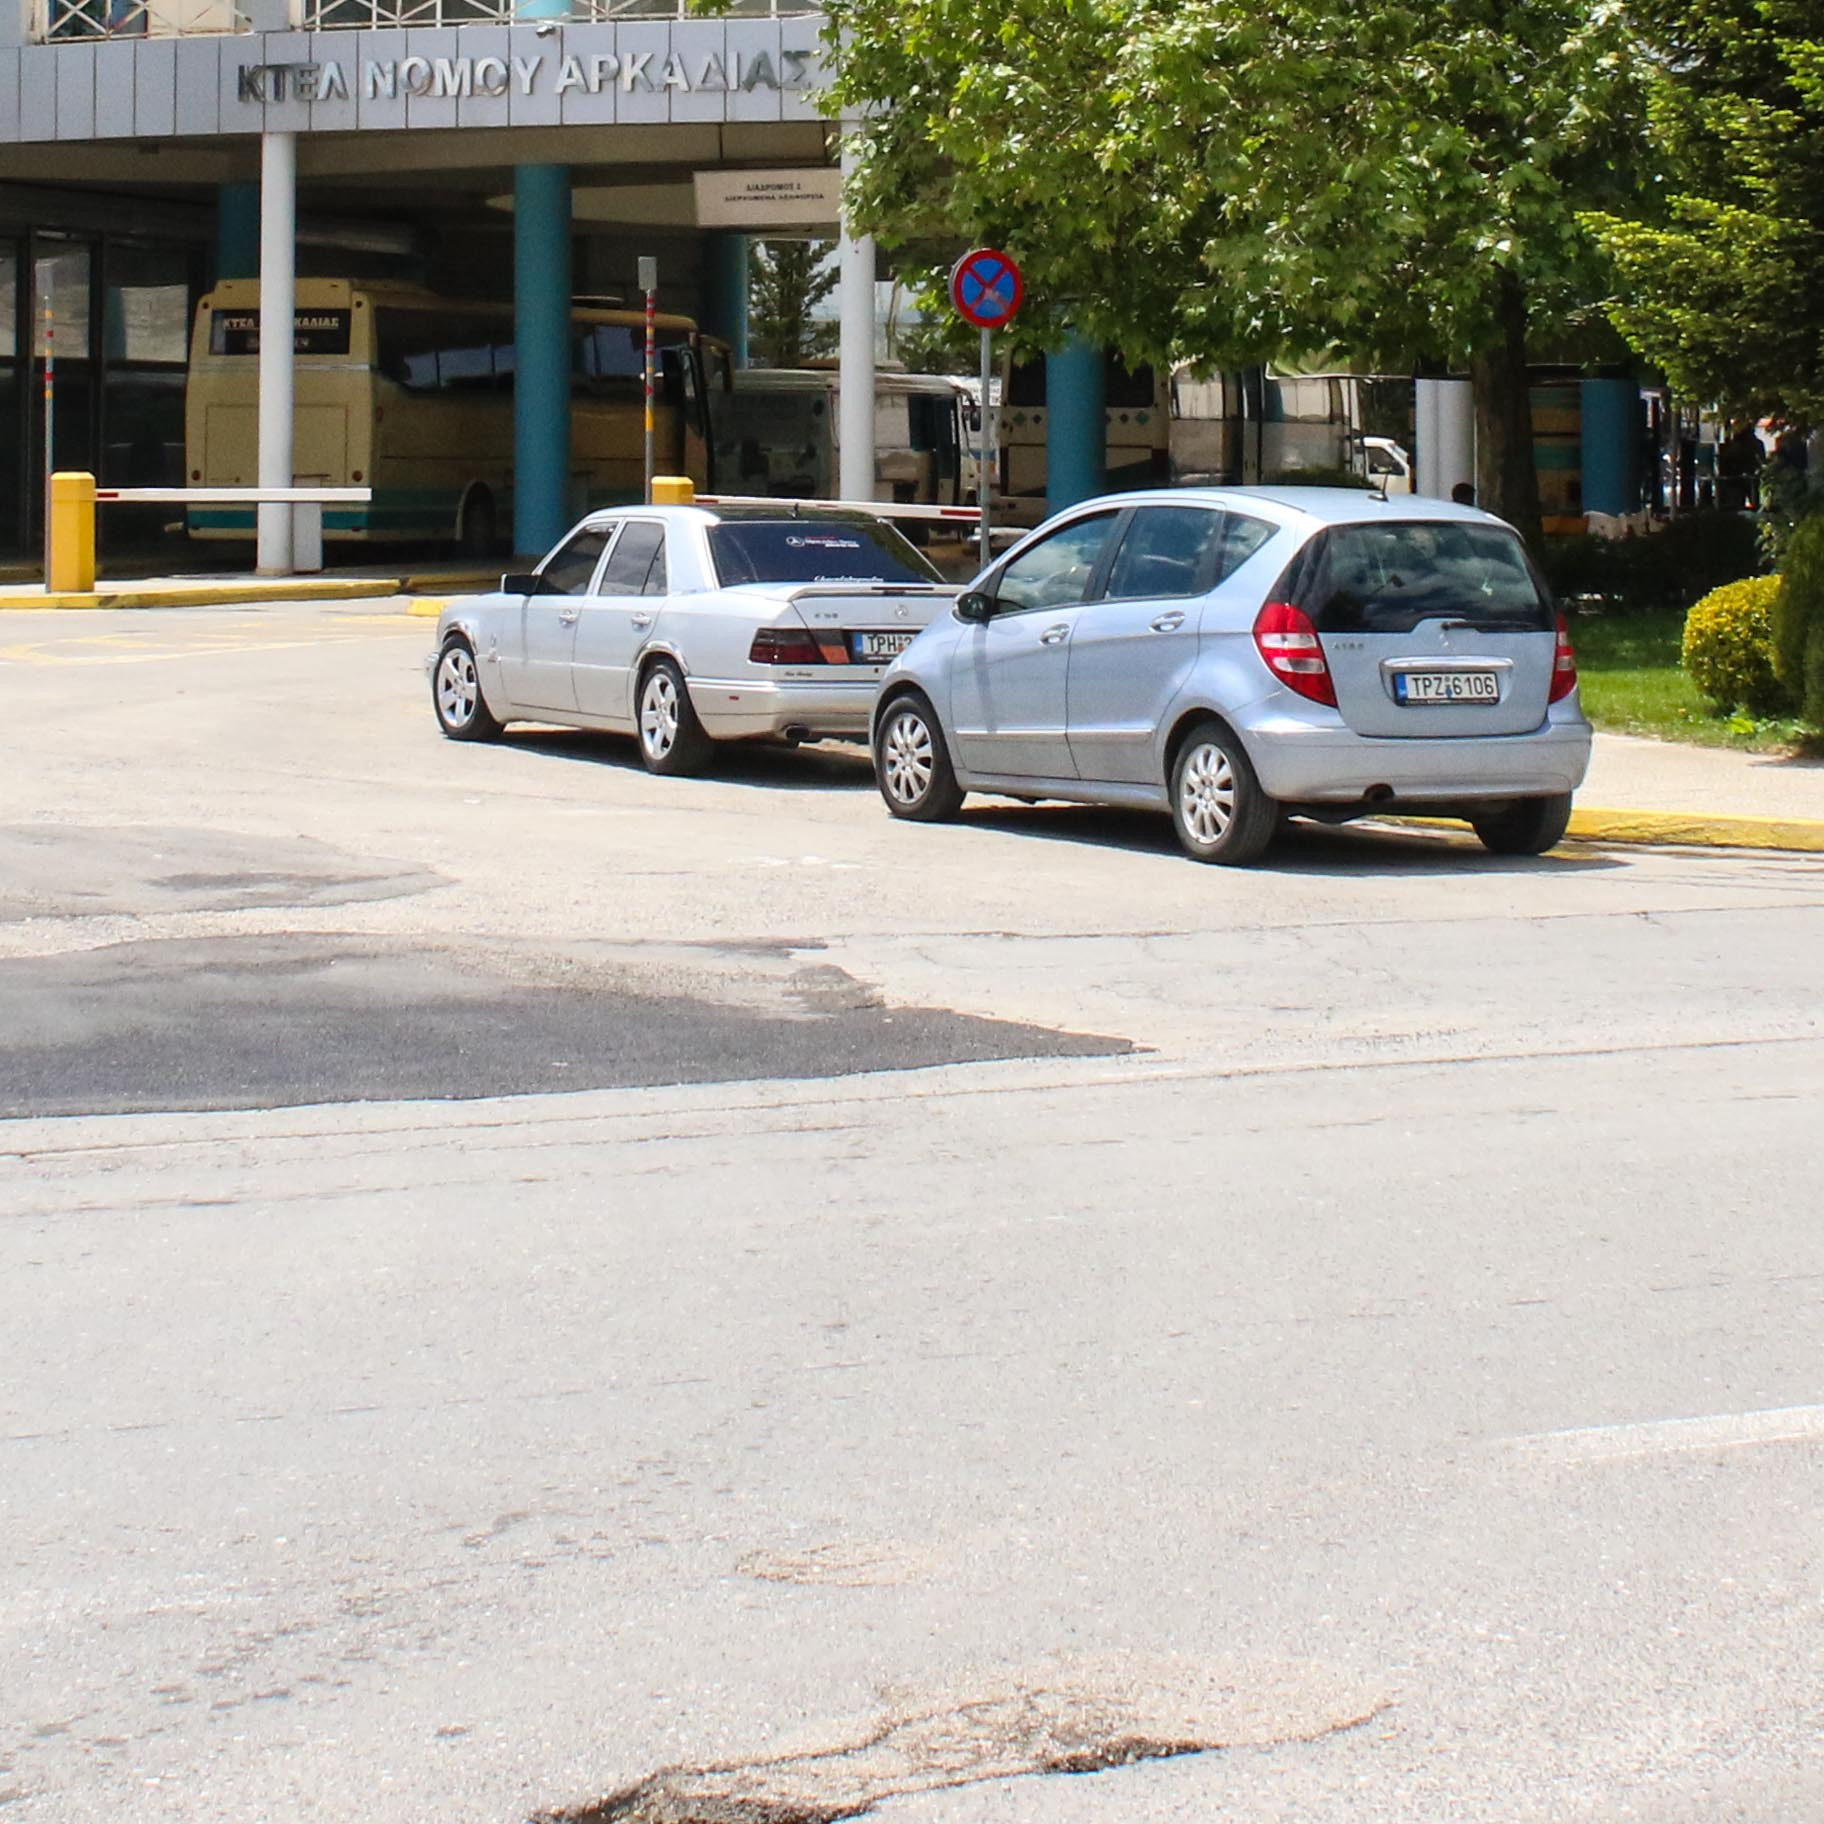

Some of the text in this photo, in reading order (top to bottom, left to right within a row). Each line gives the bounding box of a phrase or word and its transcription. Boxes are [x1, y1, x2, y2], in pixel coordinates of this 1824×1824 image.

[238, 50, 812, 102] ΚΤΕΛ ΝΟΜΟΥ ΑΡΚΑΔΙΑΣ
